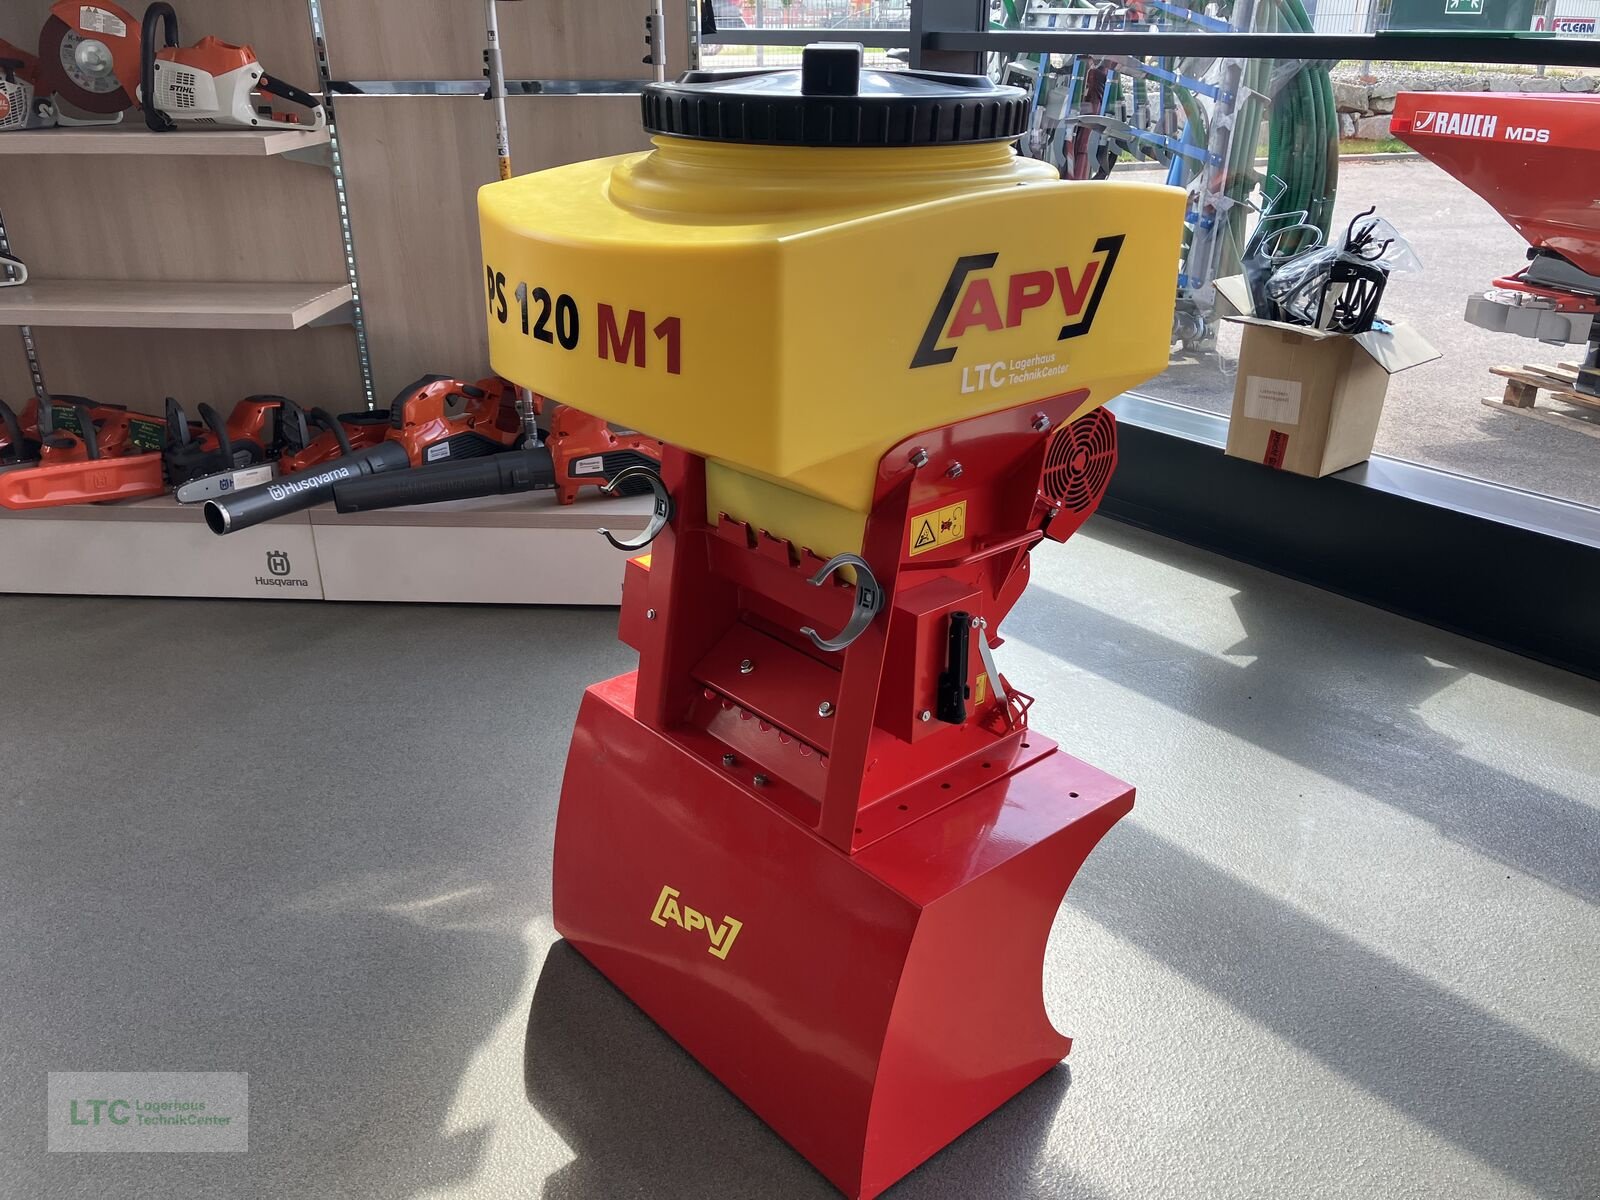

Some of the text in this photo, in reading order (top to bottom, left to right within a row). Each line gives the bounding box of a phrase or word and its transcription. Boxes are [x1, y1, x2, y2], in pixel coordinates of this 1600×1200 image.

[1561, 22, 1595, 33] CLEAN
[169, 85, 195, 94] STIHL
[1434, 111, 1550, 143] RAUCH MDS
[486, 264, 681, 375] PS 120 M1
[1009, 352, 1056, 371] Lagerhaus
[960, 361, 1007, 394] LTC
[1008, 364, 1070, 385] TechnikCenter
[283, 467, 350, 496] Husqvarna
[255, 576, 309, 587] Husqvarna
